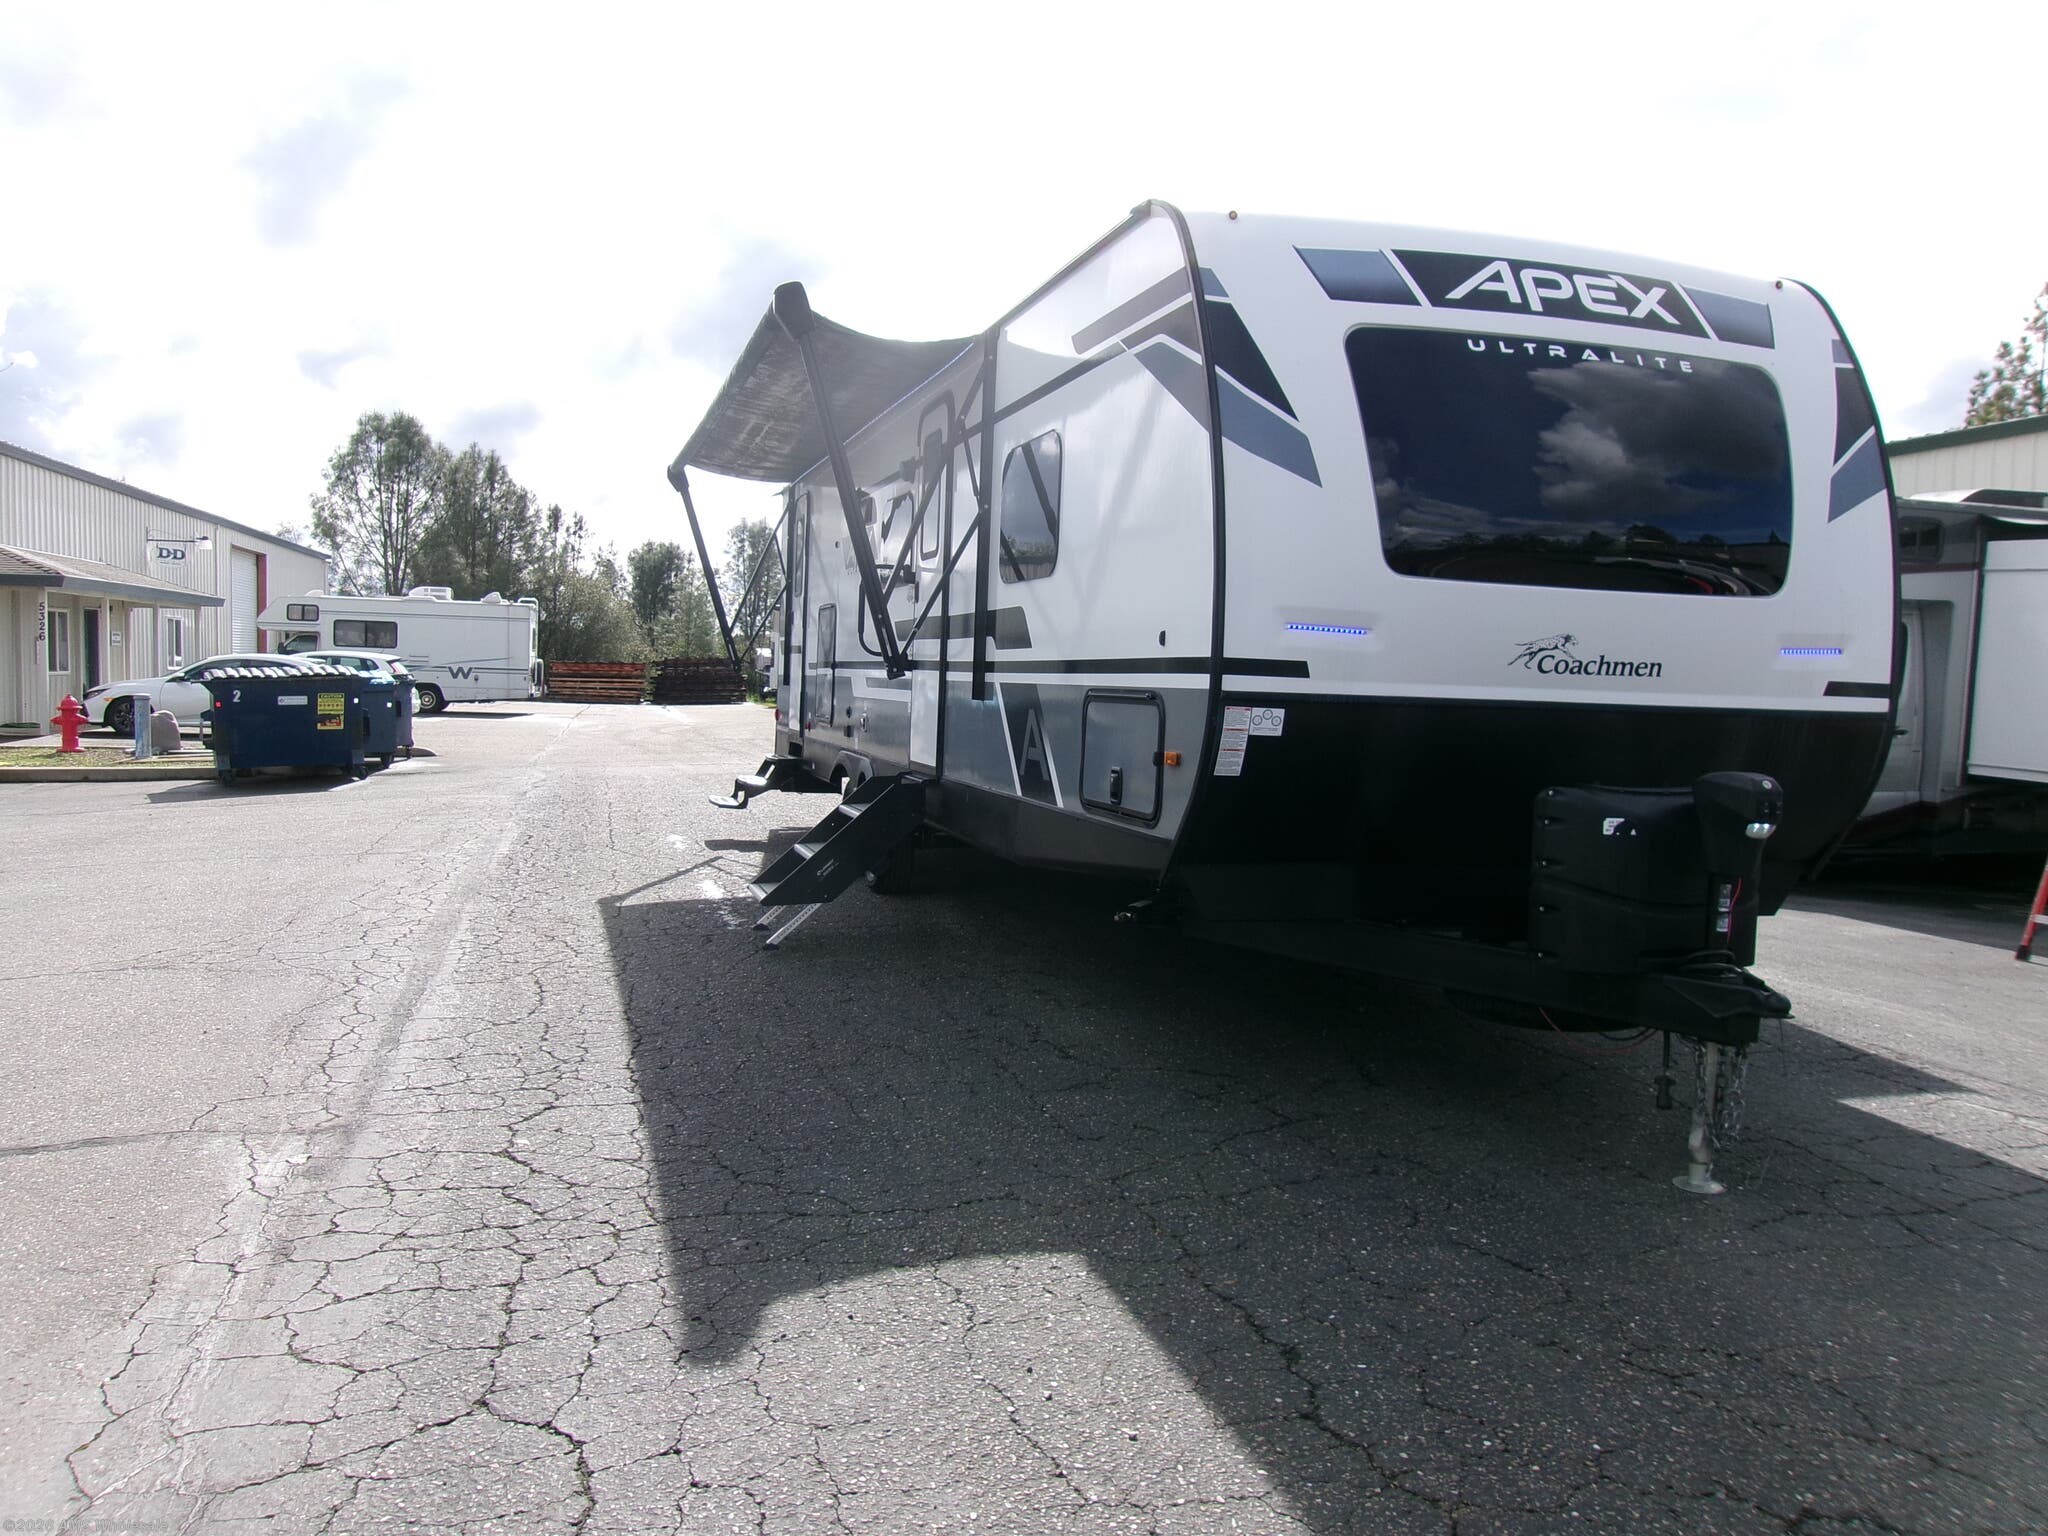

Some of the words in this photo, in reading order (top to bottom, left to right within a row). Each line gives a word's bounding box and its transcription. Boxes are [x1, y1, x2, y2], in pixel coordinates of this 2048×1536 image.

[1445, 260, 1681, 325] APEX
[1467, 338, 1693, 373] ULTRALITE
[38, 601, 46, 641] 5326
[448, 666, 473, 679] W
[1537, 655, 1663, 677] Coachmen
[232, 690, 241, 703] 2
